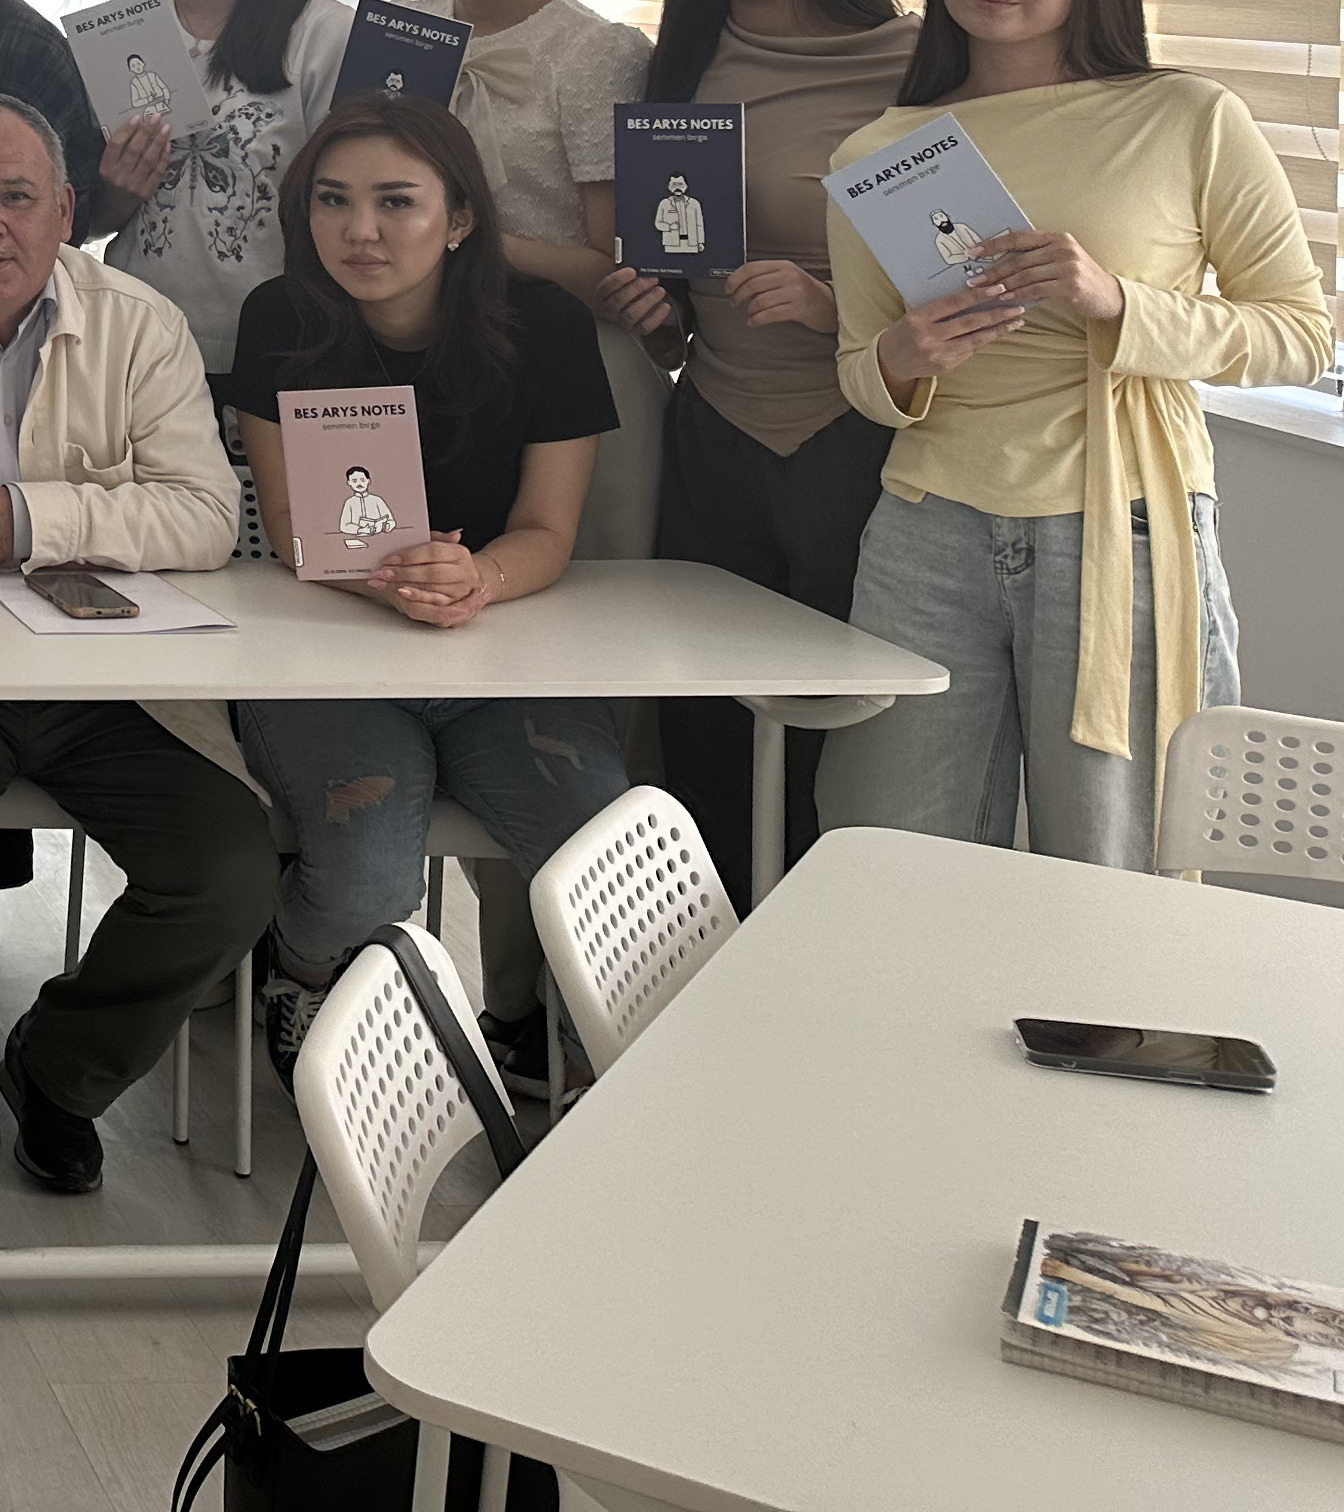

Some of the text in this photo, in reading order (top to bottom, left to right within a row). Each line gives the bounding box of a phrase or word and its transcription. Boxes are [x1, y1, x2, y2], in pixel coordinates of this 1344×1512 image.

[76, 20, 96, 34] BES
[97, 11, 125, 27] ARYS
[366, 12, 460, 46] BES ARYS NOTES
[627, 118, 734, 130] BES ARYS NOTES
[846, 135, 959, 199] BES ARYS NOTES
[294, 404, 406, 419] BES ARYS NOTES
